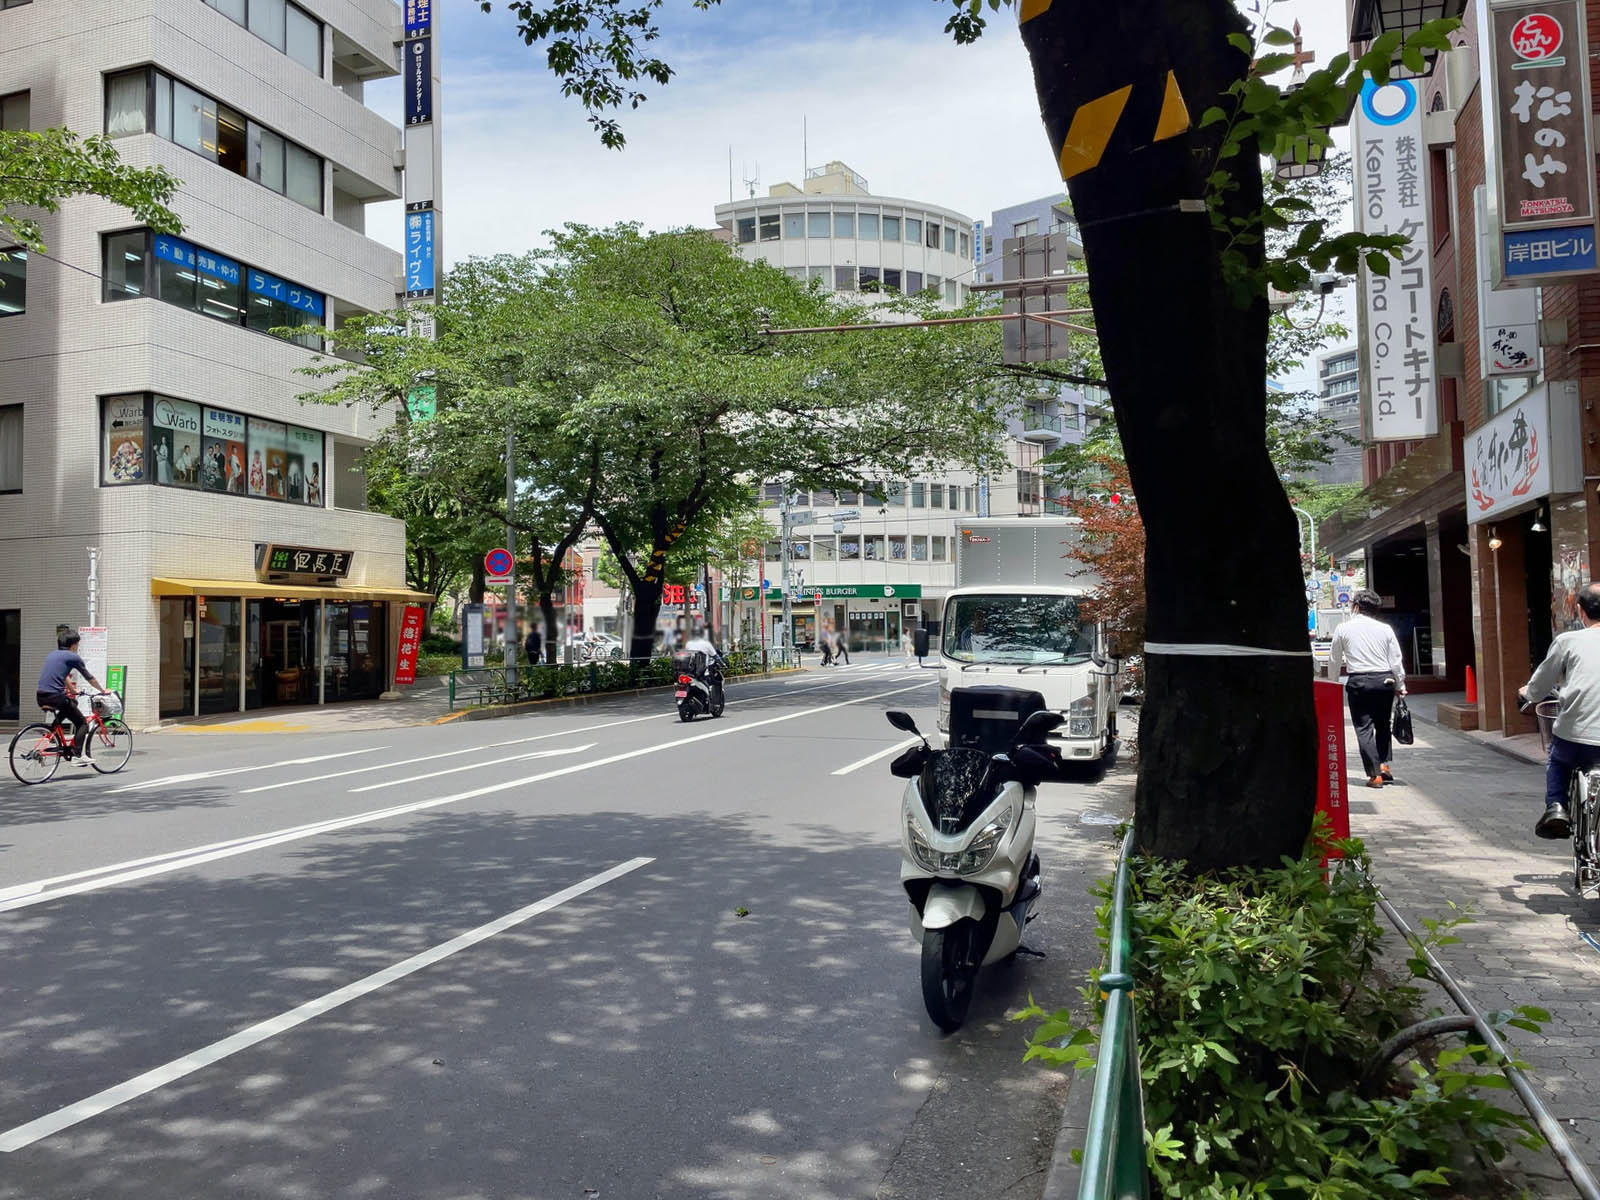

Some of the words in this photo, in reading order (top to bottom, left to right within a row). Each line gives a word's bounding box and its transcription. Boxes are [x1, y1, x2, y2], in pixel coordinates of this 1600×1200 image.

[1516, 16, 1553, 58] とんかつ
[1511, 80, 1572, 188] 松のや
[1366, 139, 1386, 219] Kenko
[1395, 135, 1420, 209] 株式会社
[1521, 198, 1567, 209] TONKATSU
[1521, 205, 1574, 216] MATSUNOYA
[159, 241, 239, 280] 不動産売買・仲介
[1508, 238, 1593, 263] 岸田ビル
[254, 275, 314, 310] ライヴス
[1398, 218, 1431, 420] ケンコー・トキナー
[1374, 322, 1393, 370] Co.,
[210, 411, 241, 425] 証明写真
[1377, 376, 1396, 421] Ltd.
[166, 413, 198, 431] Warb
[825, 587, 858, 596] BURGER
